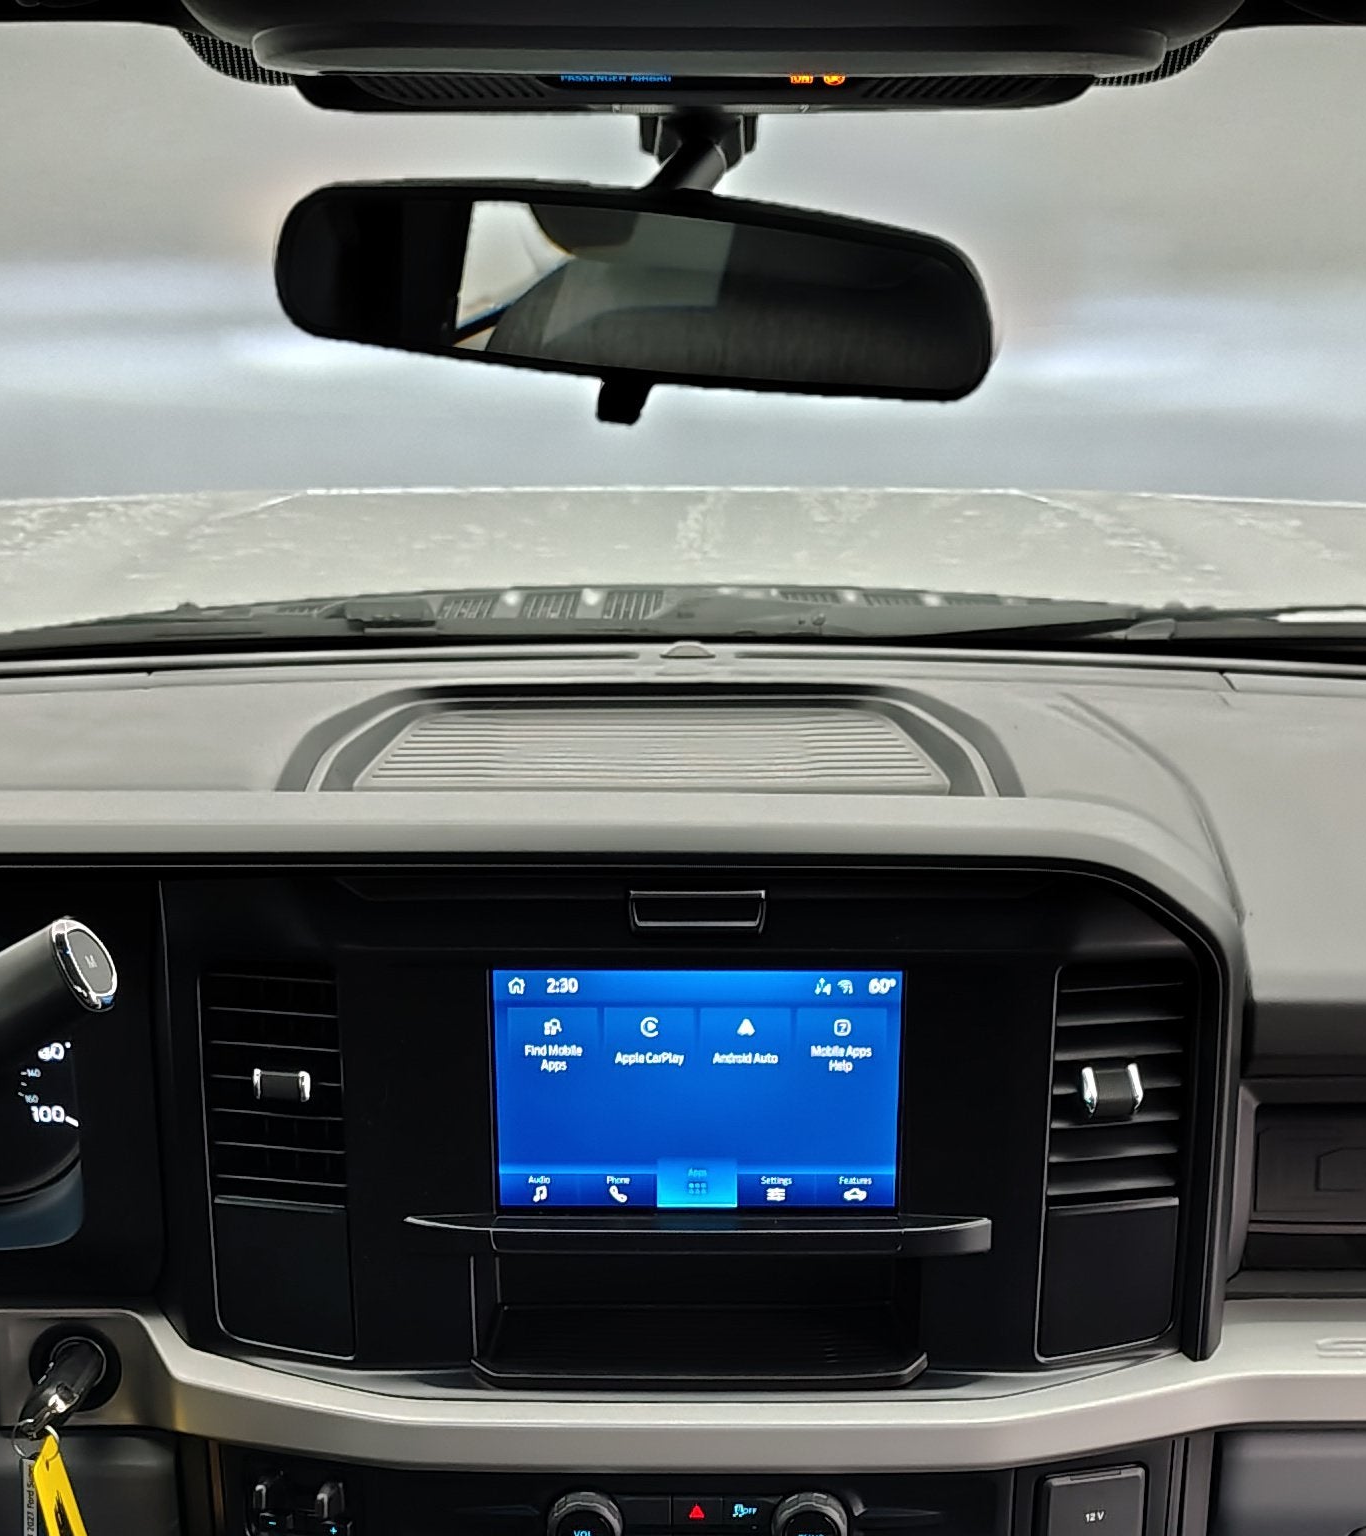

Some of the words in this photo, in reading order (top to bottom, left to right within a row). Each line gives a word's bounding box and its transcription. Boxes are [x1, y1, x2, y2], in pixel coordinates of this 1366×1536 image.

[546, 977, 579, 994] 2:30
[524, 1045, 547, 1056] Find
[548, 1045, 583, 1056] Mobile
[811, 1046, 845, 1057] Mobile
[845, 1046, 872, 1058] Apps
[615, 1052, 645, 1065] Apple
[646, 1052, 685, 1066] CarPlay
[713, 1052, 752, 1064] Android
[753, 1052, 778, 1064] Auto
[541, 1060, 567, 1073] Apps
[829, 1060, 853, 1073] Help
[30, 1105, 65, 1123] 100
[528, 1176, 551, 1185] Audio
[606, 1176, 630, 1185] Phone
[760, 1175, 793, 1187] Settings
[838, 1176, 872, 1186] Features
[26, 1490, 35, 1508] Ford
[1086, 1512, 1096, 1521] 12
[1096, 1511, 1105, 1520] V
